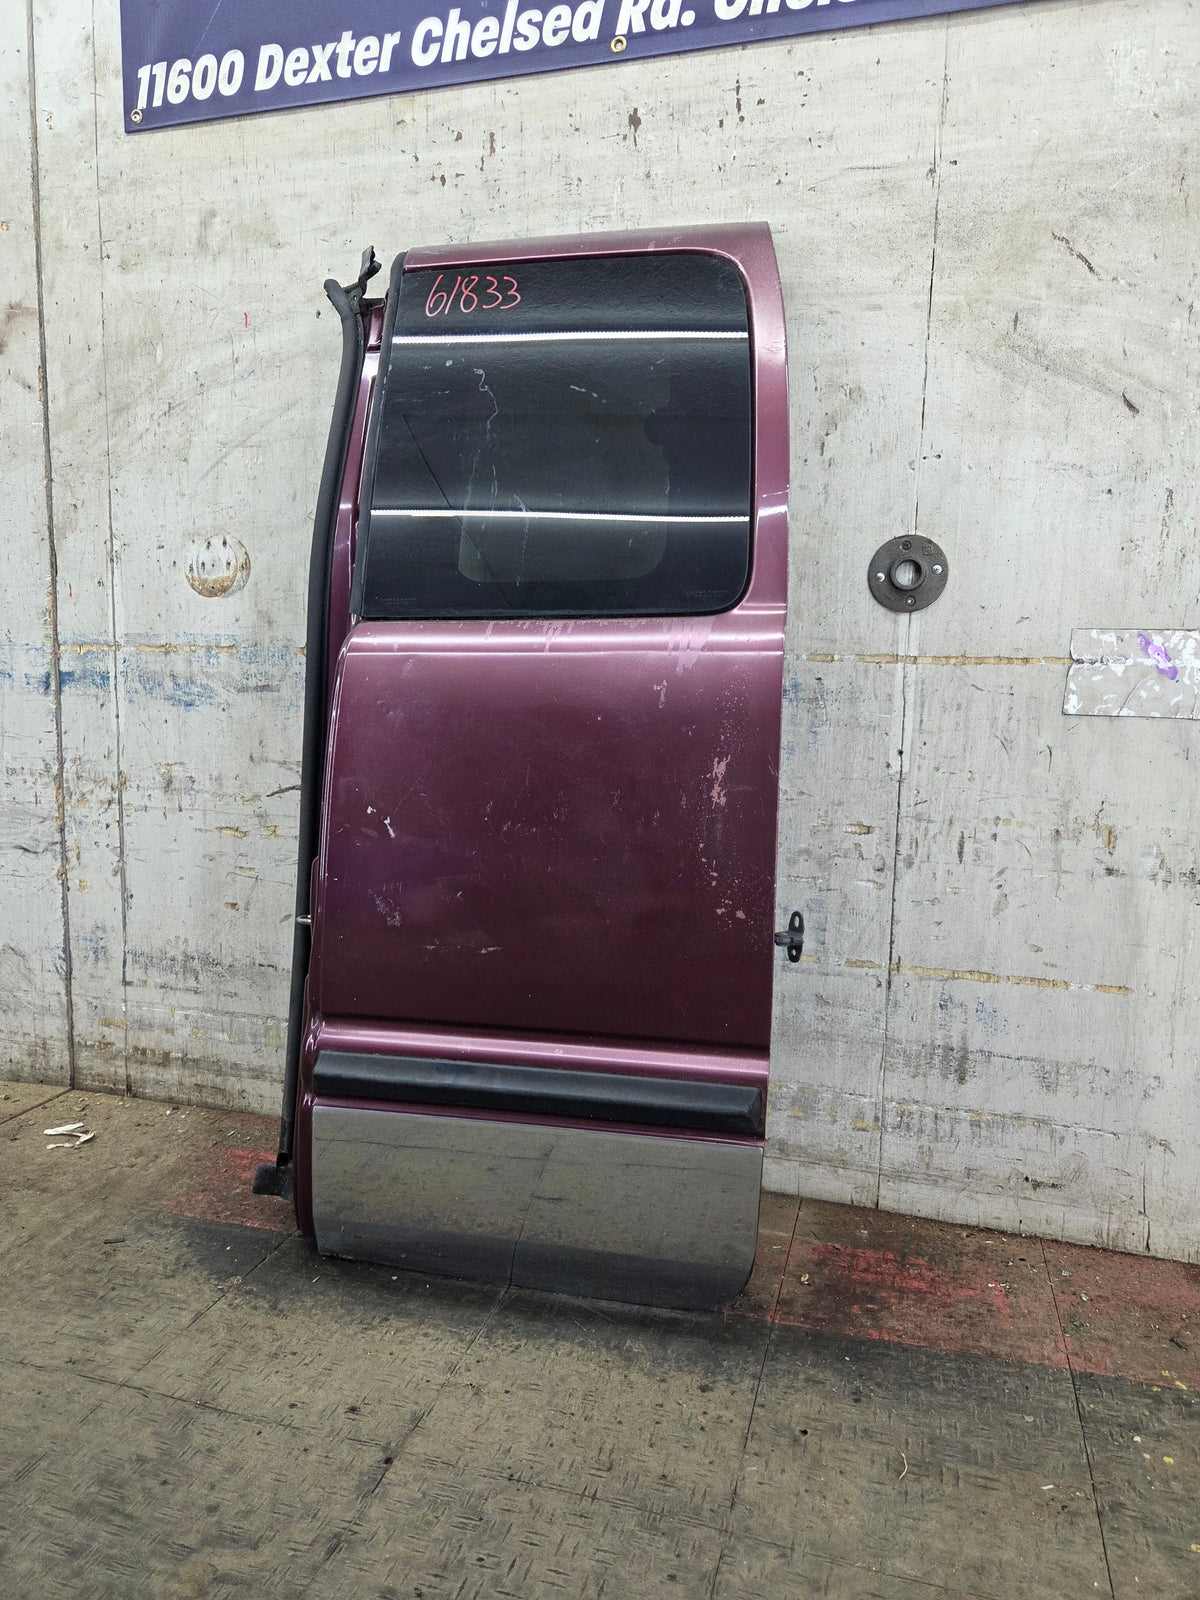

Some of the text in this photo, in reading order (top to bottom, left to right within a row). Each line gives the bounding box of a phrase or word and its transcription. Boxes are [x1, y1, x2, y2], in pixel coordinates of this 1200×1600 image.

[136, 49, 245, 110] 11600
[254, 30, 402, 92] Dexter
[425, 274, 522, 318] 61833
